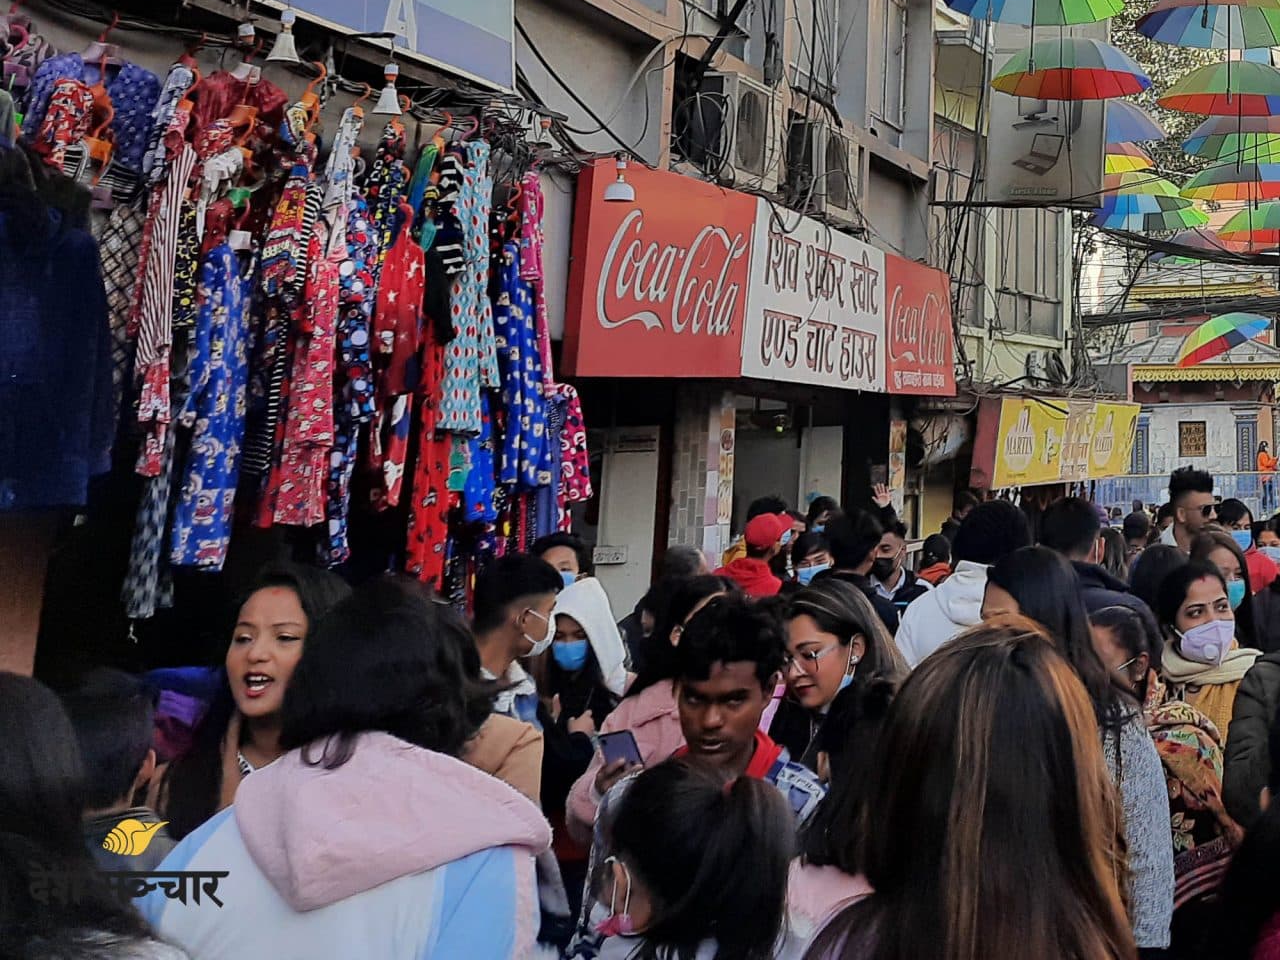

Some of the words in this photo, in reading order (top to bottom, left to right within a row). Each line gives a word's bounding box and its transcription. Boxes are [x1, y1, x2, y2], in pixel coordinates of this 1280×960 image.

[596, 209, 748, 337] Coca-Cola
[765, 212, 801, 293] शिव
[805, 230, 846, 308] शंकर
[805, 319, 837, 374] चाट
[840, 327, 878, 384] हाउस
